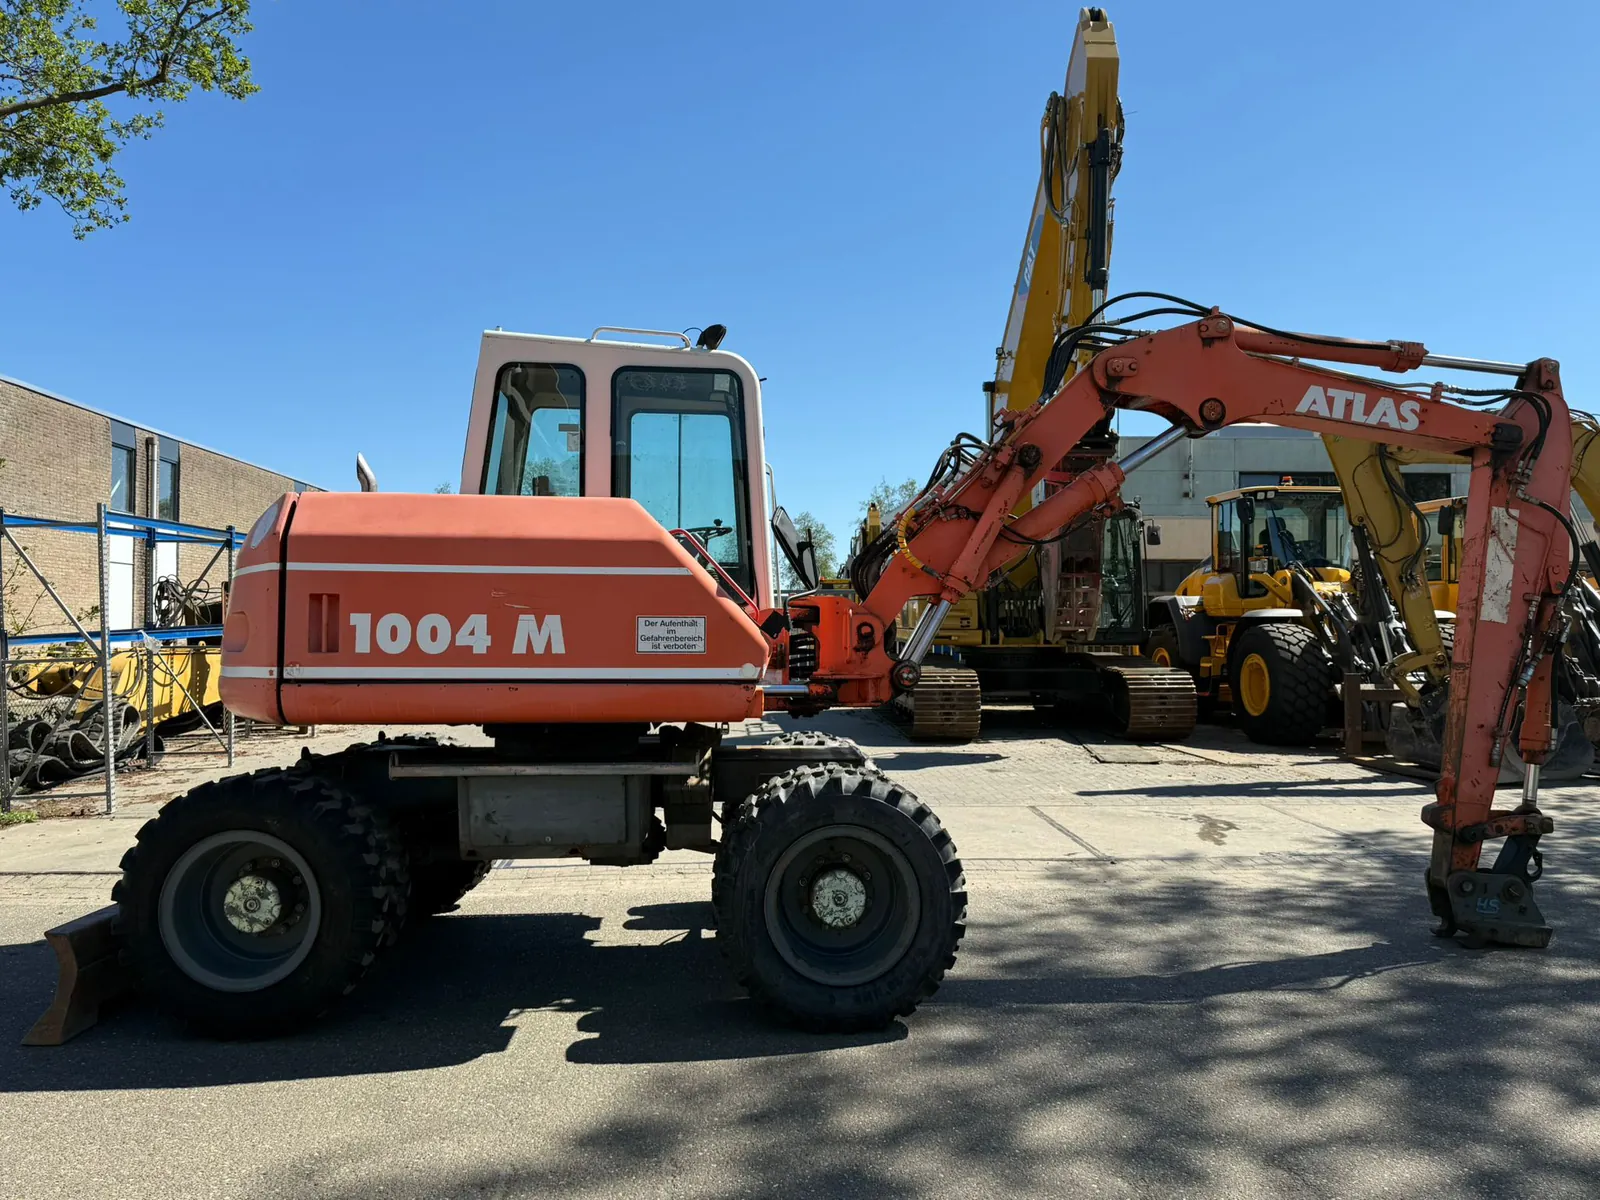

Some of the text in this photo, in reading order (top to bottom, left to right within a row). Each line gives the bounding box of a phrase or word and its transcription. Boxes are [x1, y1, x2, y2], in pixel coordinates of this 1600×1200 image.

[1295, 385, 1420, 431] ATLAS
[350, 613, 566, 654] 1004 M
[644, 619, 698, 627] Der Aufenthalt
[651, 642, 697, 650] ist verboten
